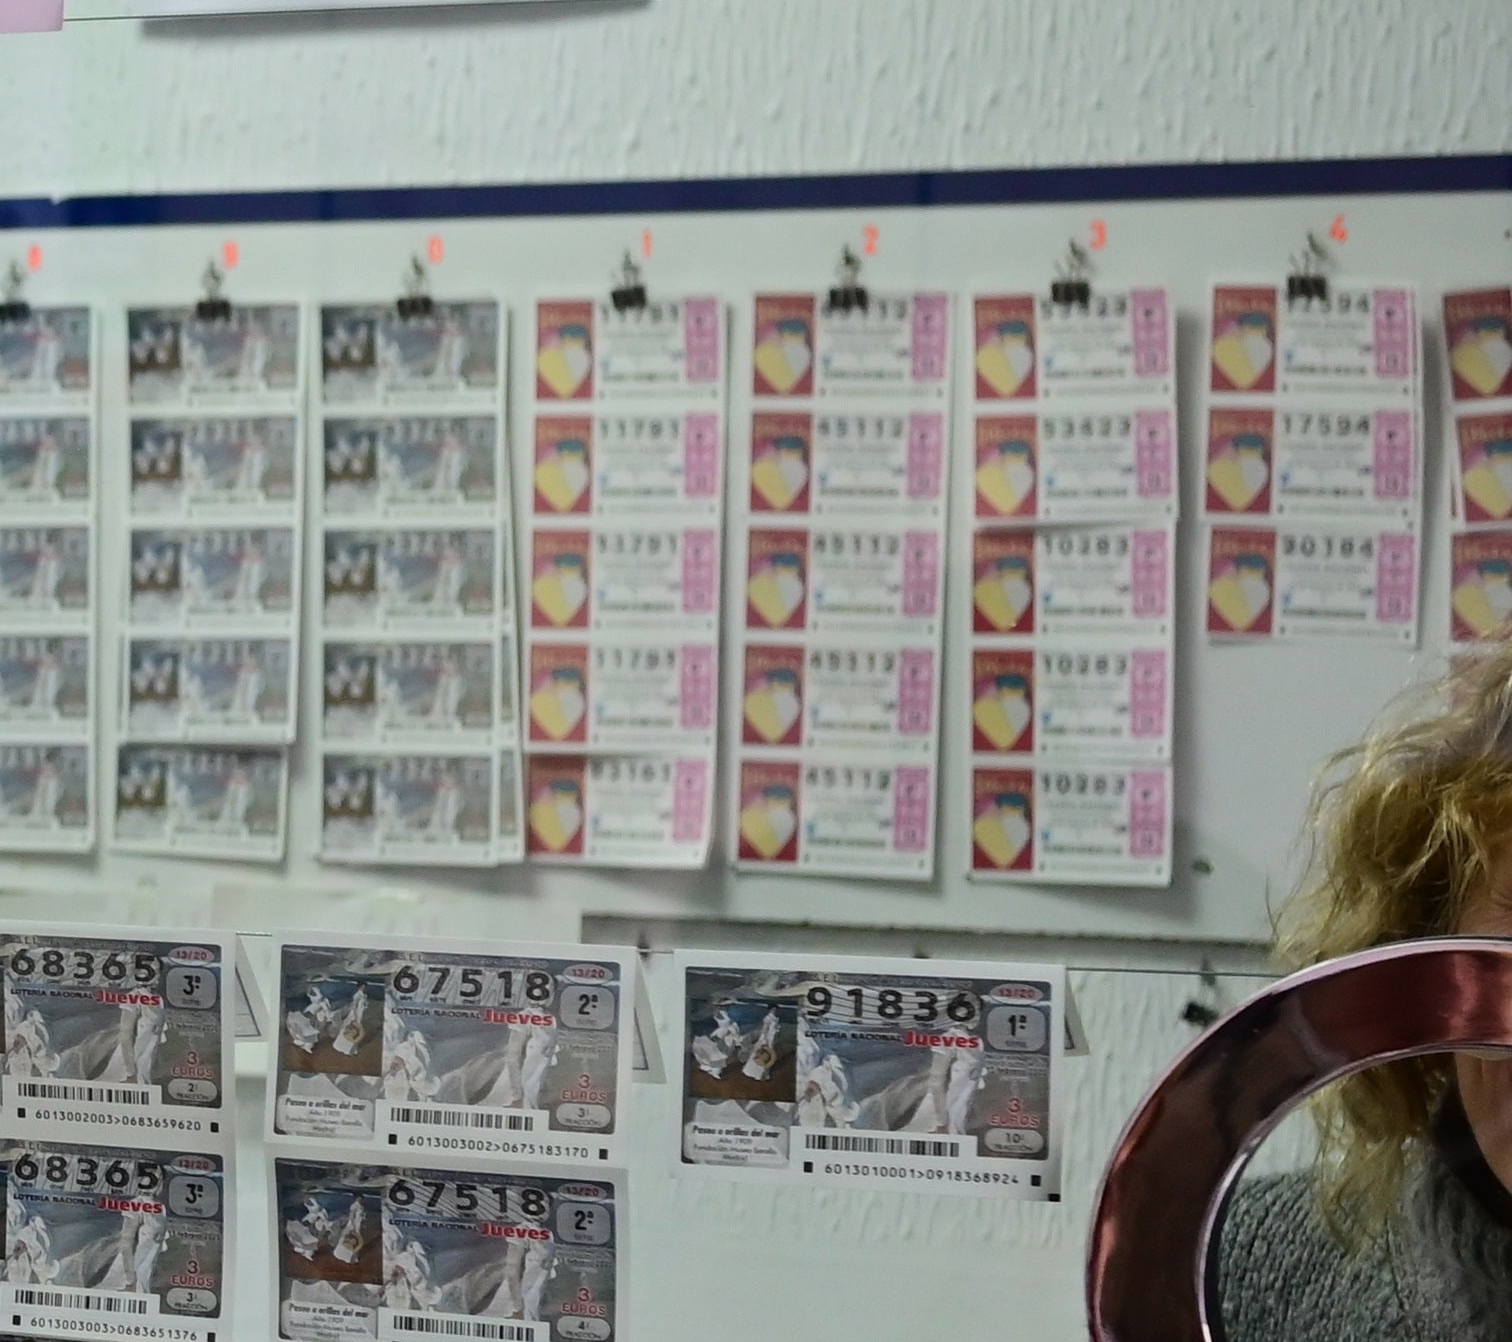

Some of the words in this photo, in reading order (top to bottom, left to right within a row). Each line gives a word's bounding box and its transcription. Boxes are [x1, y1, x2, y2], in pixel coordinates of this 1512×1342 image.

[10, 949, 156, 983] 68365
[392, 965, 550, 1001] 67518
[806, 987, 977, 1022] 91836
